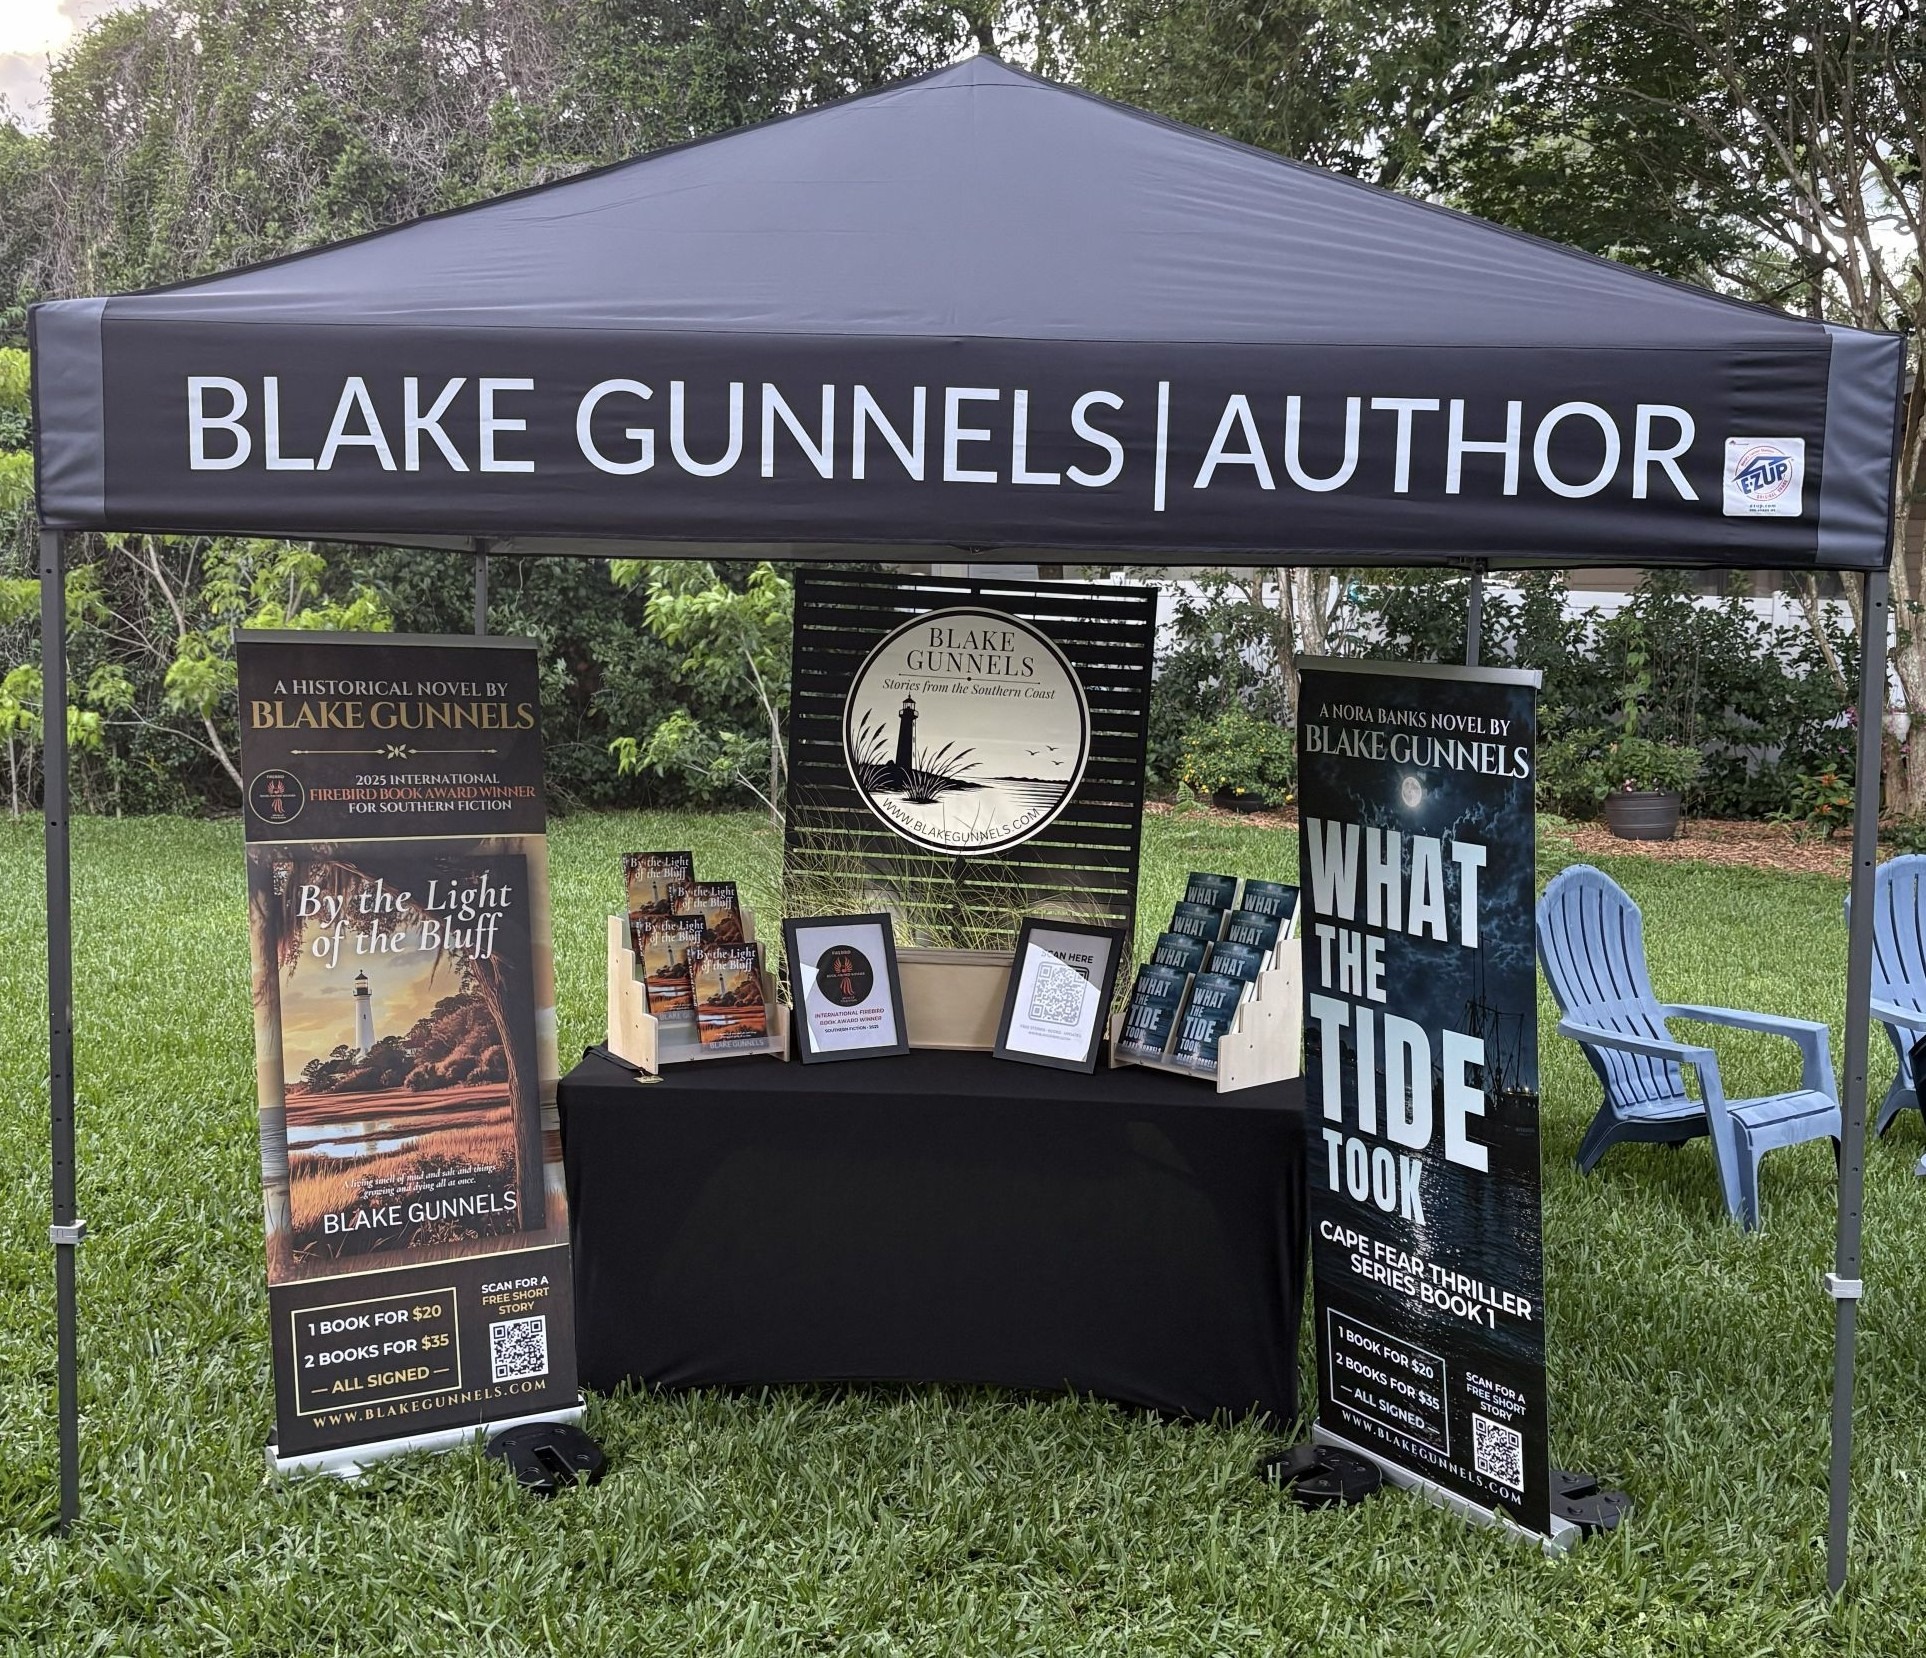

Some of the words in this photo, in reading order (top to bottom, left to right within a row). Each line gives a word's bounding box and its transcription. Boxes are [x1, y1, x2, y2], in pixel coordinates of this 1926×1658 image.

[187, 376, 535, 473] BLAKE
[577, 379, 1124, 487] GUNNELS
[1193, 394, 1700, 501] AUTHOR
[929, 627, 1015, 653] BLAKE
[906, 650, 1035, 677] GUNNELS
[274, 681, 288, 695] A
[293, 680, 413, 696] HISTORICAL
[418, 681, 482, 697] NOVEL
[486, 683, 508, 697] BY
[882, 678, 920, 692] Stories
[922, 680, 948, 694] from
[951, 682, 969, 695] the
[971, 684, 1021, 698] Southern
[1024, 687, 1056, 700] Coast
[251, 700, 365, 729] BLAKE
[371, 702, 535, 730] GUNNELS
[1319, 703, 1330, 718] A
[1333, 704, 1374, 723] NORA
[1378, 709, 1427, 729] BANKS
[1431, 713, 1486, 735] NOVEL
[1489, 719, 1511, 737] BY
[1305, 724, 1387, 762] BLAKE
[1391, 733, 1530, 779] GUNNELS
[356, 774, 387, 786] 2025
[390, 773, 500, 785] INTERNATIONAL
[310, 787, 377, 801] FIREBIRD
[380, 787, 422, 800] BOOK
[425, 786, 477, 799] AWARD
[479, 786, 536, 798] WINNER
[349, 801, 377, 813] FOR
[379, 801, 455, 813] SOUTHERN
[458, 799, 512, 811] FICTION
[882, 797, 1041, 843] WWW.BLAKEGUNNELS.COM
[630, 857, 643, 868] By
[647, 855, 662, 867] the
[665, 855, 689, 869] Light
[635, 868, 646, 880] of
[647, 867, 661, 878] the
[663, 866, 688, 880] Bluff
[678, 886, 691, 898] By
[694, 885, 708, 897] the
[711, 885, 734, 899] Light
[1306, 816, 1487, 949] WHAT
[297, 884, 344, 929] By
[359, 878, 412, 914] the
[425, 873, 512, 921] Light
[682, 898, 693, 910] of
[694, 897, 708, 908] the
[710, 896, 733, 910] Bluff
[1187, 886, 1219, 906] WHAT
[1244, 893, 1280, 916] WHAT
[645, 921, 658, 934] By
[661, 920, 676, 931] the
[680, 919, 704, 934] Light
[650, 932, 660, 945] of
[661, 931, 676, 942] the
[679, 930, 702, 944] Bluff
[1173, 915, 1207, 937] WHAT
[1229, 925, 1263, 946] WHAT
[311, 919, 349, 969] of
[356, 919, 406, 955] the
[418, 912, 503, 960] Bluff
[696, 949, 709, 961] By
[713, 947, 728, 959] the
[731, 946, 756, 961] Light
[1069, 953, 1094, 964] HERE
[1155, 947, 1190, 969] WHAT
[1315, 922, 1387, 1004] THE
[701, 960, 712, 974] of
[713, 959, 727, 970] the
[729, 958, 754, 972] Bluff
[1211, 955, 1245, 977] WHAT
[1138, 976, 1172, 998] WHAT
[1193, 987, 1226, 1009] WHAT
[1134, 993, 1149, 1006] THE
[1190, 1004, 1205, 1018] THE
[815, 1010, 859, 1019] INTERNATIONAL
[1128, 1004, 1162, 1031] TIDE
[1125, 1026, 1146, 1041] TOOK
[1183, 1016, 1217, 1043] TIDE
[1180, 1038, 1201, 1053] TOOK
[1310, 992, 1489, 1174] TIDE
[350, 1176, 374, 1189] living
[375, 1174, 396, 1185] smell
[397, 1171, 405, 1185] of
[407, 1171, 424, 1181] mud
[425, 1168, 440, 1179] and
[442, 1166, 456, 1177] salt
[457, 1164, 472, 1175] and
[1322, 1127, 1426, 1226] TOOK
[363, 1186, 395, 1200] growing
[396, 1182, 411, 1193] and
[413, 1180, 435, 1193] dying
[436, 1177, 447, 1188] all
[448, 1178, 456, 1187] at
[457, 1177, 477, 1185] once.
[324, 1205, 402, 1235] BLAKE
[408, 1191, 517, 1223] GUNNELS
[1320, 1220, 1369, 1256] CAPE
[1374, 1241, 1424, 1277] FEAR
[1428, 1263, 1532, 1321] THRILLER
[481, 1281, 513, 1294] SCAN
[515, 1277, 538, 1290] FOR
[540, 1275, 549, 1285] A
[482, 1292, 510, 1306] FREE
[513, 1286, 549, 1302] SHORT
[1350, 1253, 1416, 1295] SERIES
[1420, 1282, 1482, 1325] BOOK
[1487, 1307, 1496, 1329] 1
[498, 1301, 535, 1315] STORY
[308, 1322, 315, 1337] 1
[320, 1315, 371, 1335] BOOK
[374, 1309, 408, 1327] FOR
[412, 1304, 442, 1322] $20
[304, 1354, 315, 1369] 2
[318, 1346, 379, 1367] BOOKS
[383, 1338, 417, 1357] FOR
[421, 1333, 449, 1352] $35
[1338, 1325, 1344, 1339] 1
[1346, 1329, 1381, 1356] BOOK
[1383, 1346, 1409, 1368] FOR
[1411, 1358, 1434, 1380] $20
[331, 1376, 363, 1395] ALL
[367, 1366, 430, 1388] SIGNED
[1336, 1352, 1344, 1366] 2
[1346, 1356, 1388, 1387] BOOKS
[1390, 1377, 1416, 1400] FOR
[1418, 1390, 1440, 1410] $35
[1466, 1371, 1493, 1390] SCAN
[1495, 1382, 1516, 1401] FOR
[1518, 1393, 1526, 1404] A
[313, 1379, 547, 1429] WWW.BLAKEGUNNELS.COM
[1354, 1387, 1377, 1408] ALL
[1379, 1399, 1425, 1430] SIGNED
[1466, 1384, 1491, 1401] FREE
[1493, 1395, 1527, 1417] SHORT
[1480, 1401, 1513, 1422] STORY
[1342, 1409, 1522, 1506] WWW.BLAKEGUNNELS.COM
